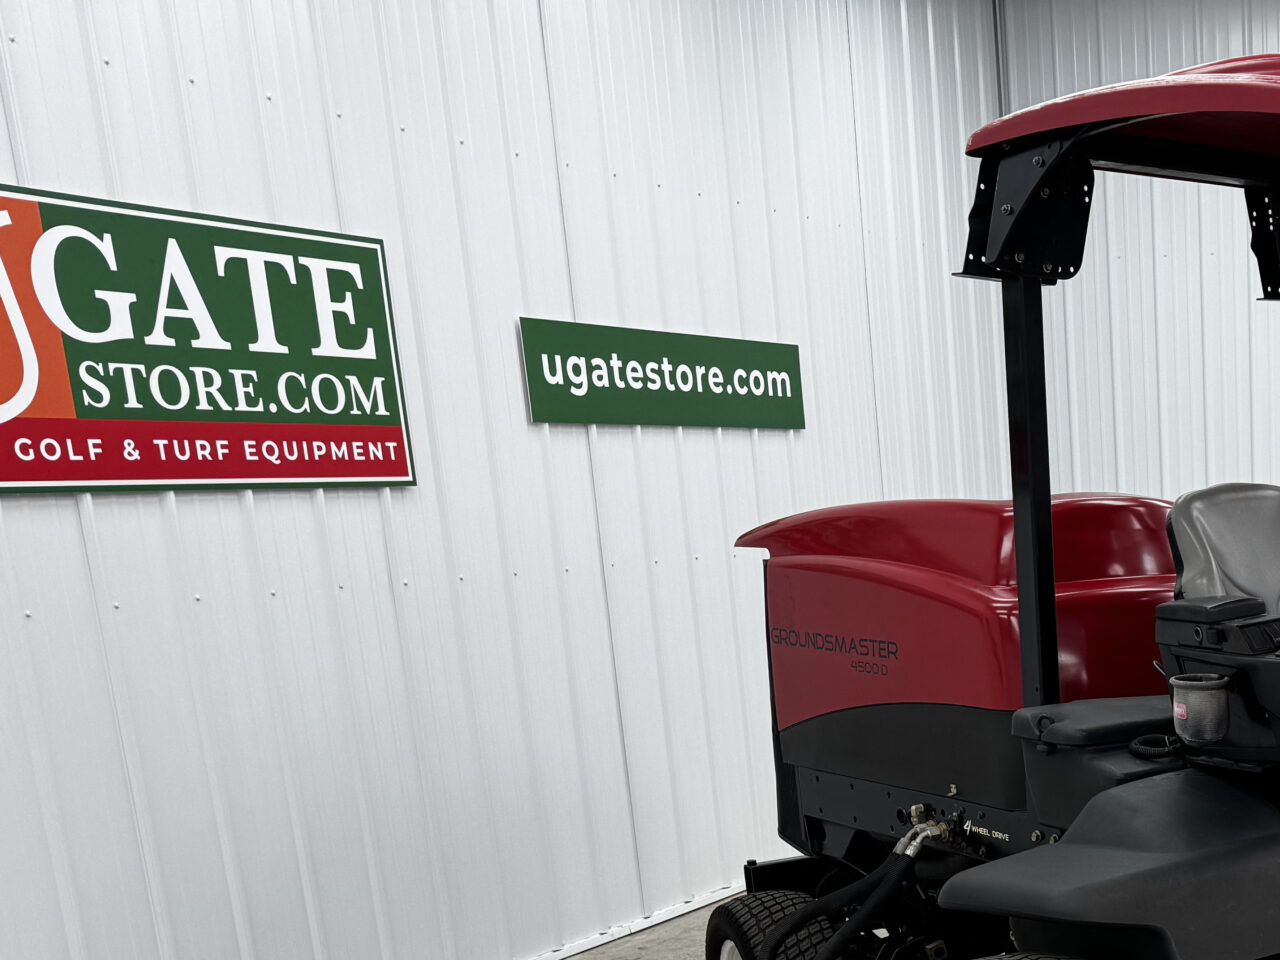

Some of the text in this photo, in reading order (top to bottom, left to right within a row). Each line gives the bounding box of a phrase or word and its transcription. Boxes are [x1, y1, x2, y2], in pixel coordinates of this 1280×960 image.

[78, 360, 391, 416] STORE.COM
[541, 353, 792, 397] ugatestore.com
[14, 438, 398, 465] GOLF & TURF EQUIPMENT
[770, 627, 899, 660] GROUNDSMASTER
[963, 819, 1010, 841] 4 WHEEL DRIVE
